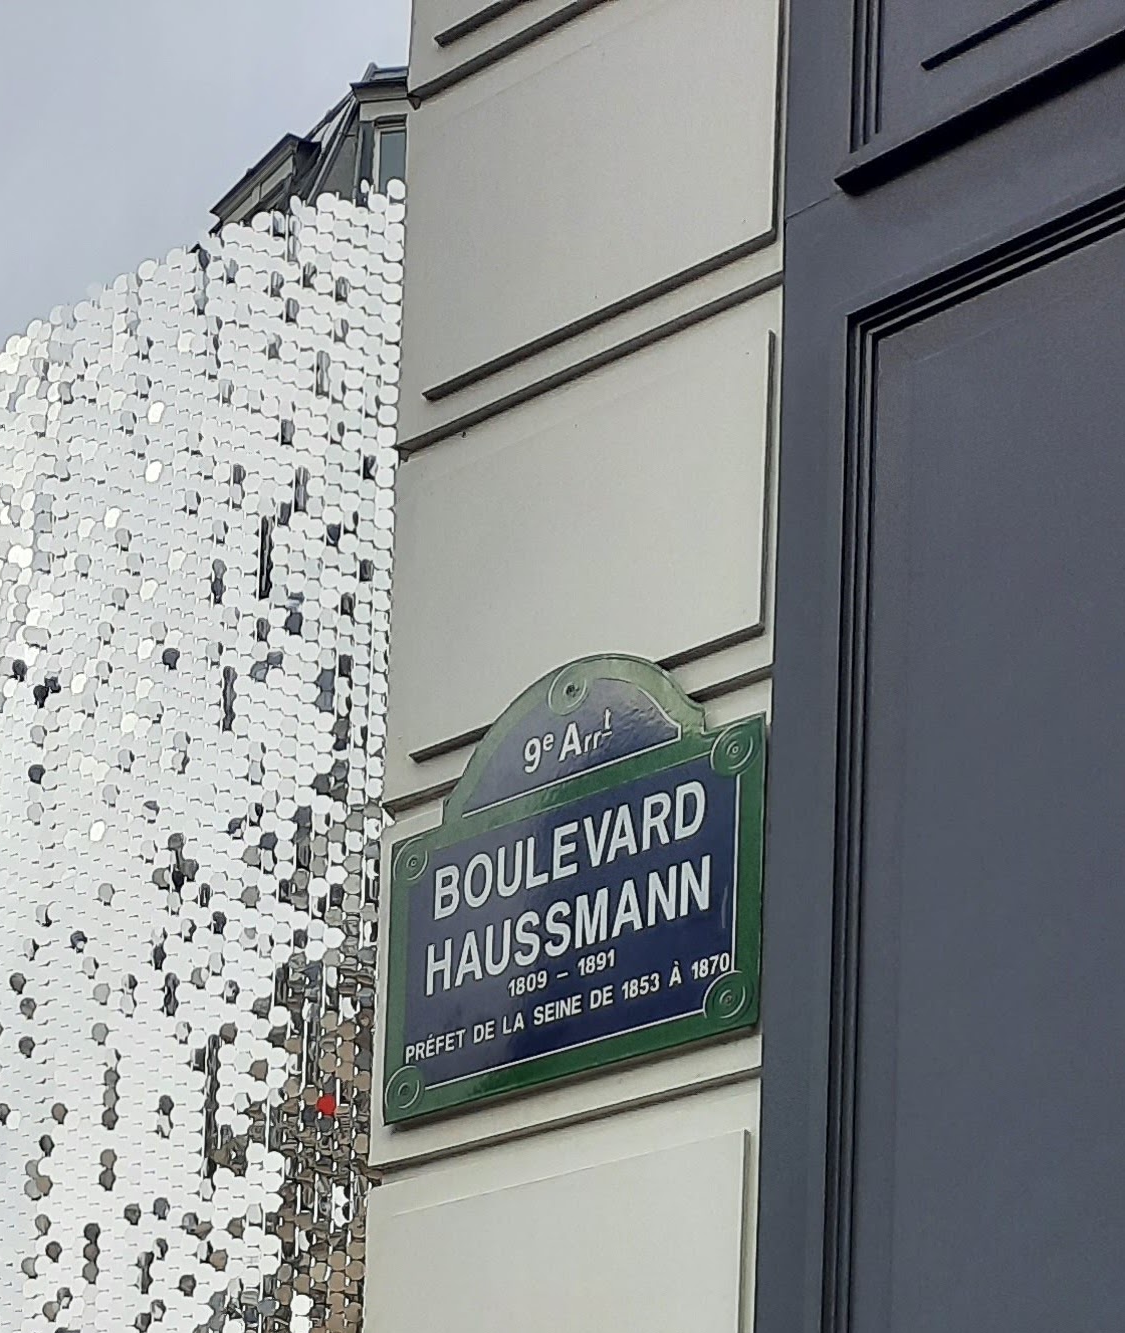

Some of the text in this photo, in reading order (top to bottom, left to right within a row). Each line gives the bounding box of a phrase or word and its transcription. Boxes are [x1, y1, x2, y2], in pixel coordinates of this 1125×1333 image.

[433, 780, 707, 921] BOULEVARD
[425, 854, 712, 997] HAUSSMANN
[507, 969, 548, 998] 1809
[577, 948, 616, 978] 1891
[404, 952, 731, 1065] PRÉFET DE LA SEINE DE 1853 À 1870
